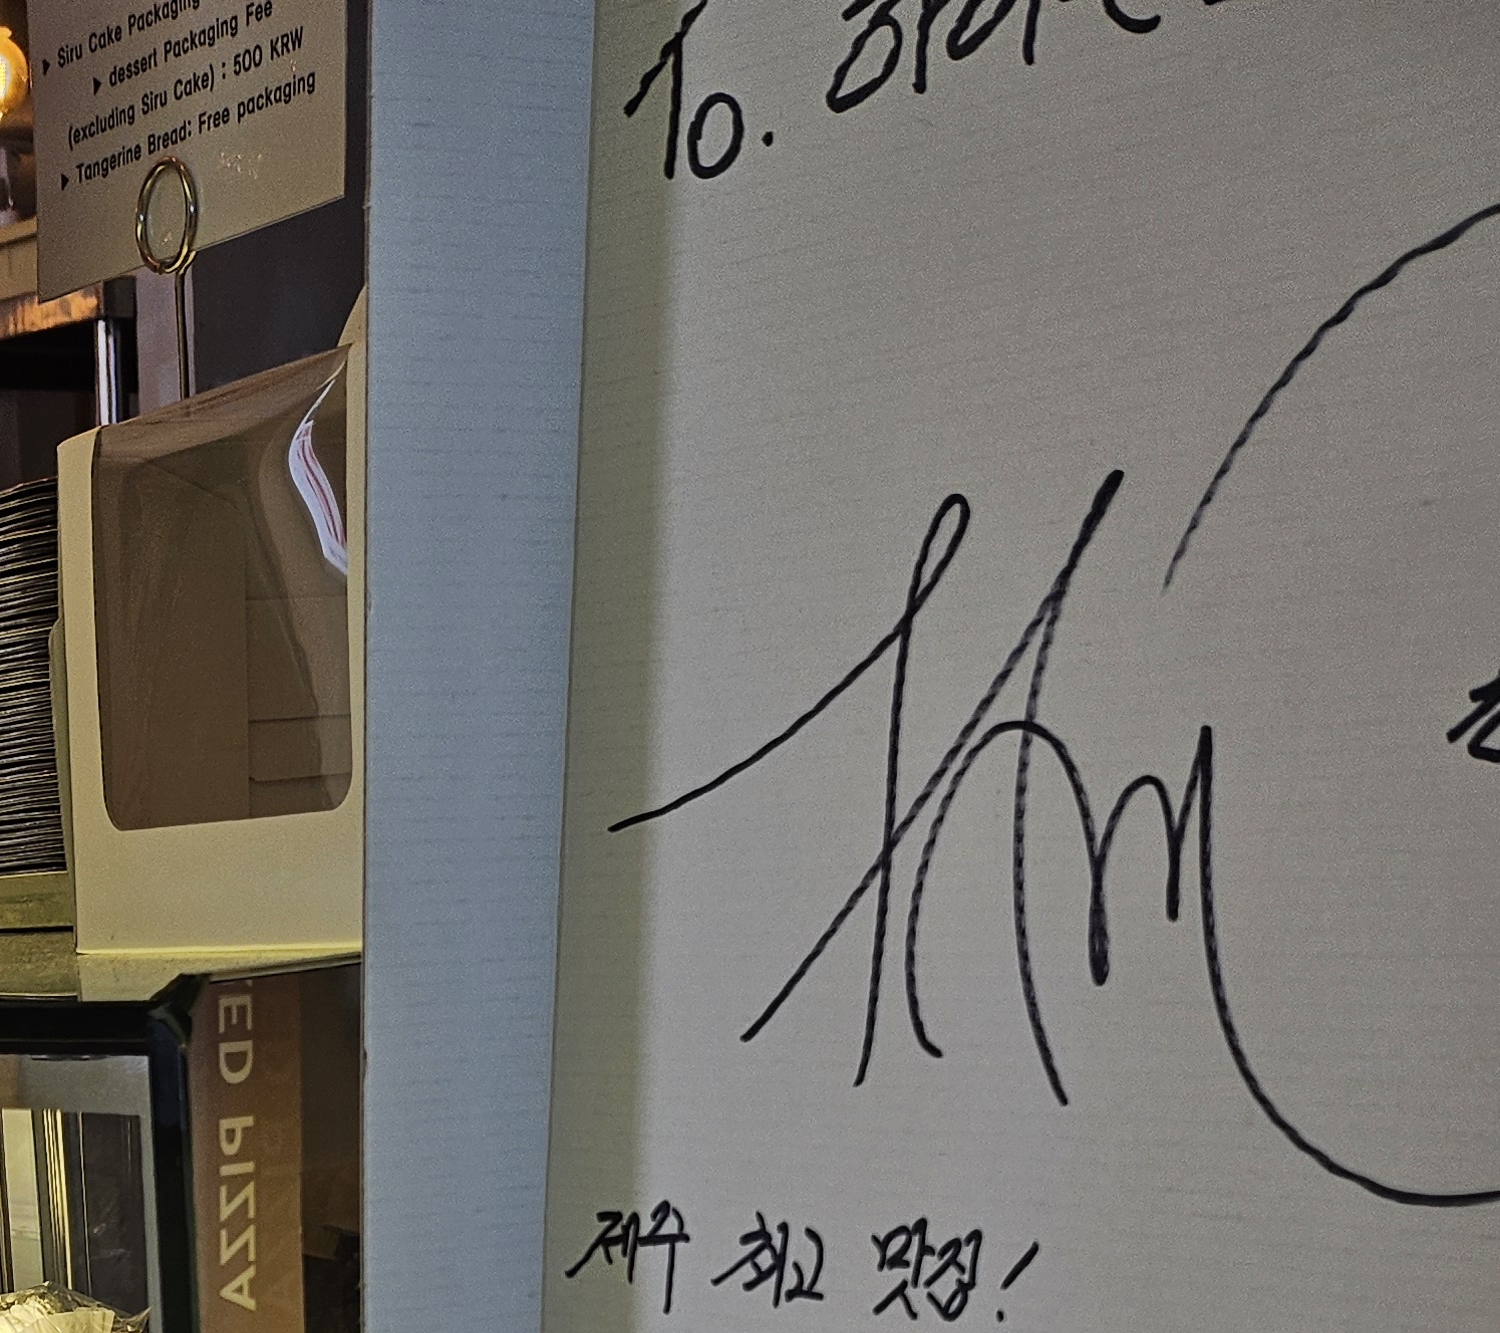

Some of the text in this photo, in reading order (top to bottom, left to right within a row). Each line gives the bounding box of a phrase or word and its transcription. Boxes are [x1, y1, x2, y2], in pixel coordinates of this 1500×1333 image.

[57, 0, 200, 68] Siru Cake Packaging
[67, 104, 136, 151] (excluding
[141, 87, 168, 115] Siru
[173, 63, 216, 100] Cake)
[233, 43, 263, 77] 500
[270, 26, 304, 61] KRW
[109, 0, 273, 88] dessert Packaging Fee
[76, 71, 316, 185] Tangerine Bread: Free packaging
[218, 982, 257, 1312] ED PIZZA
[564, 1200, 690, 1314] 제주
[710, 1213, 825, 1308] 최고
